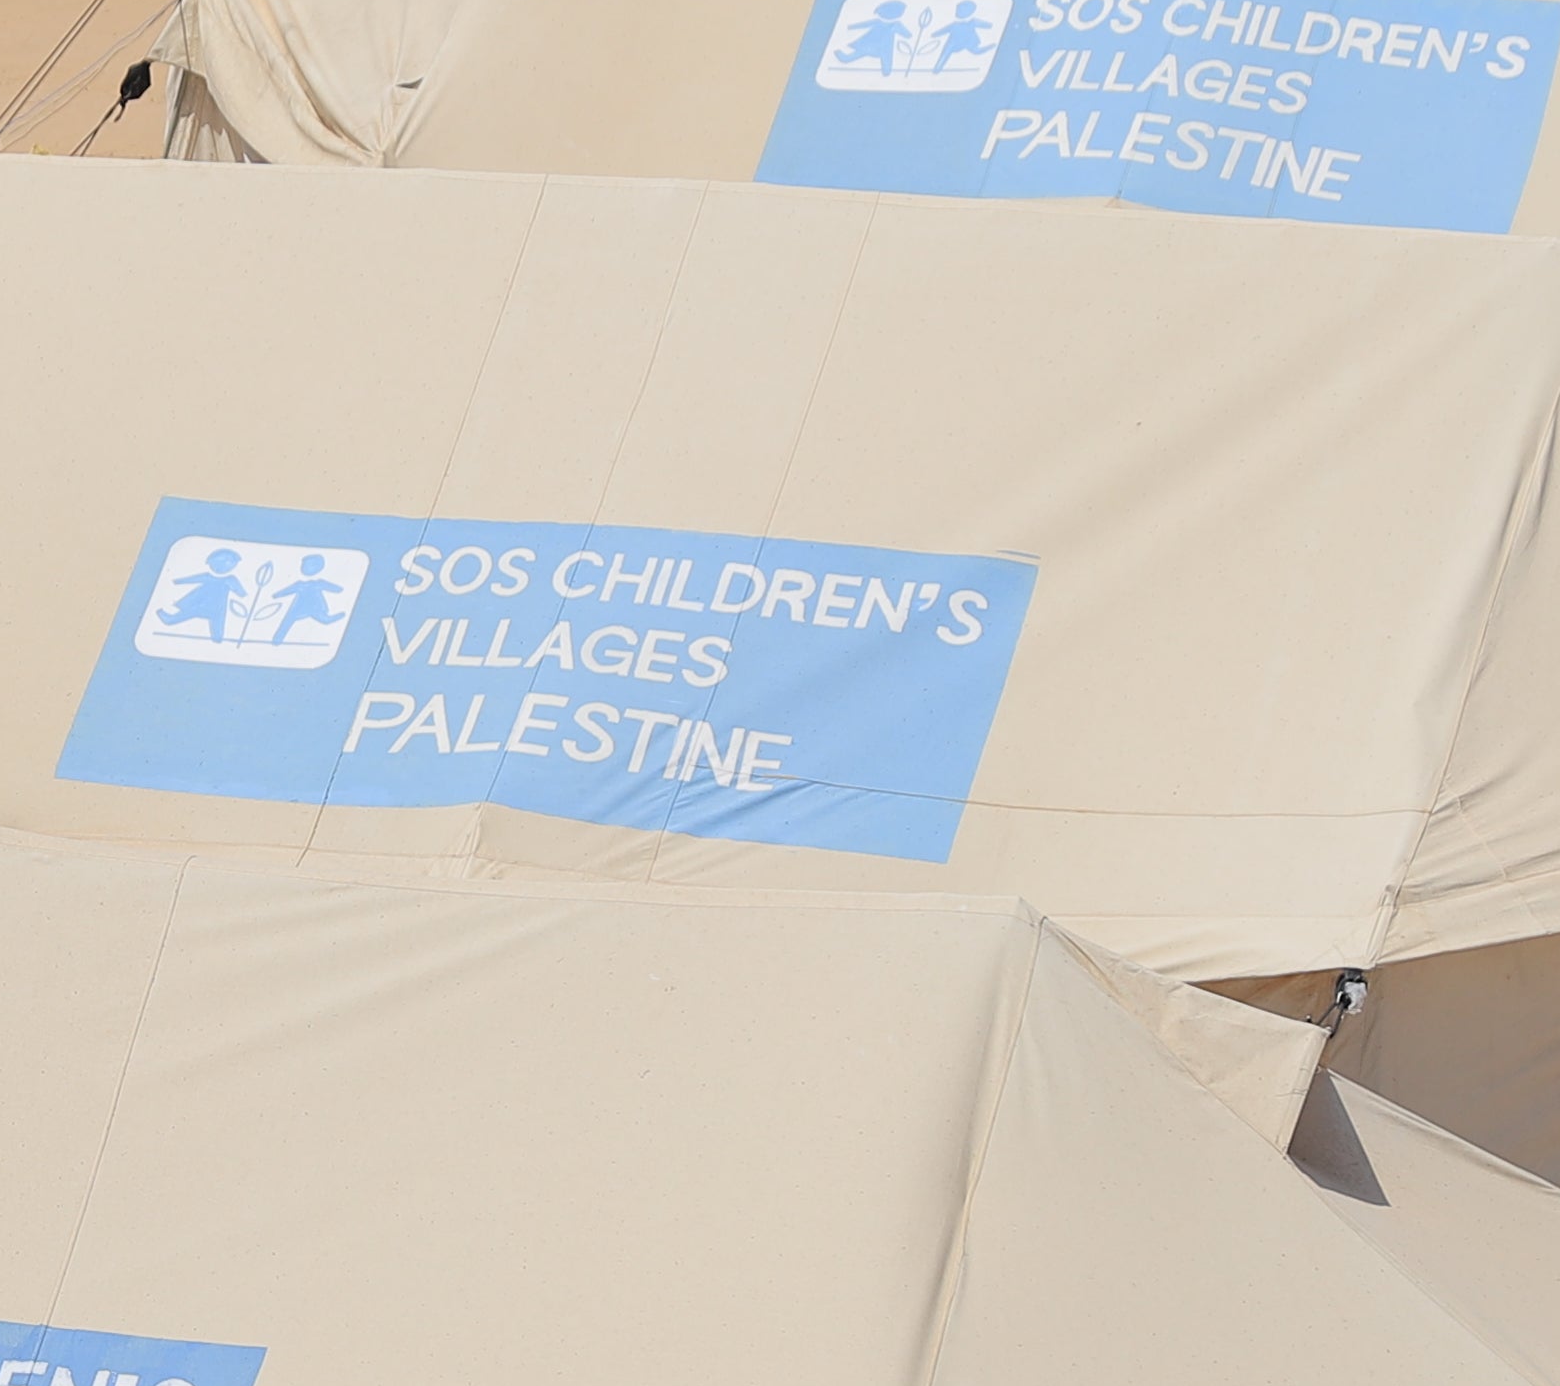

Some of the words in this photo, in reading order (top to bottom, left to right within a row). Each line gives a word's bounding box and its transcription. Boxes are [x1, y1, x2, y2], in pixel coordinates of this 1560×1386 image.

[1019, 49, 1312, 114] VILLAGES
[980, 109, 1362, 202] PALESTINE
[394, 544, 537, 597] SOS
[551, 550, 988, 646] CHILDREN'S
[381, 616, 733, 688] VILLAGES
[342, 691, 793, 793] PALESTINE
